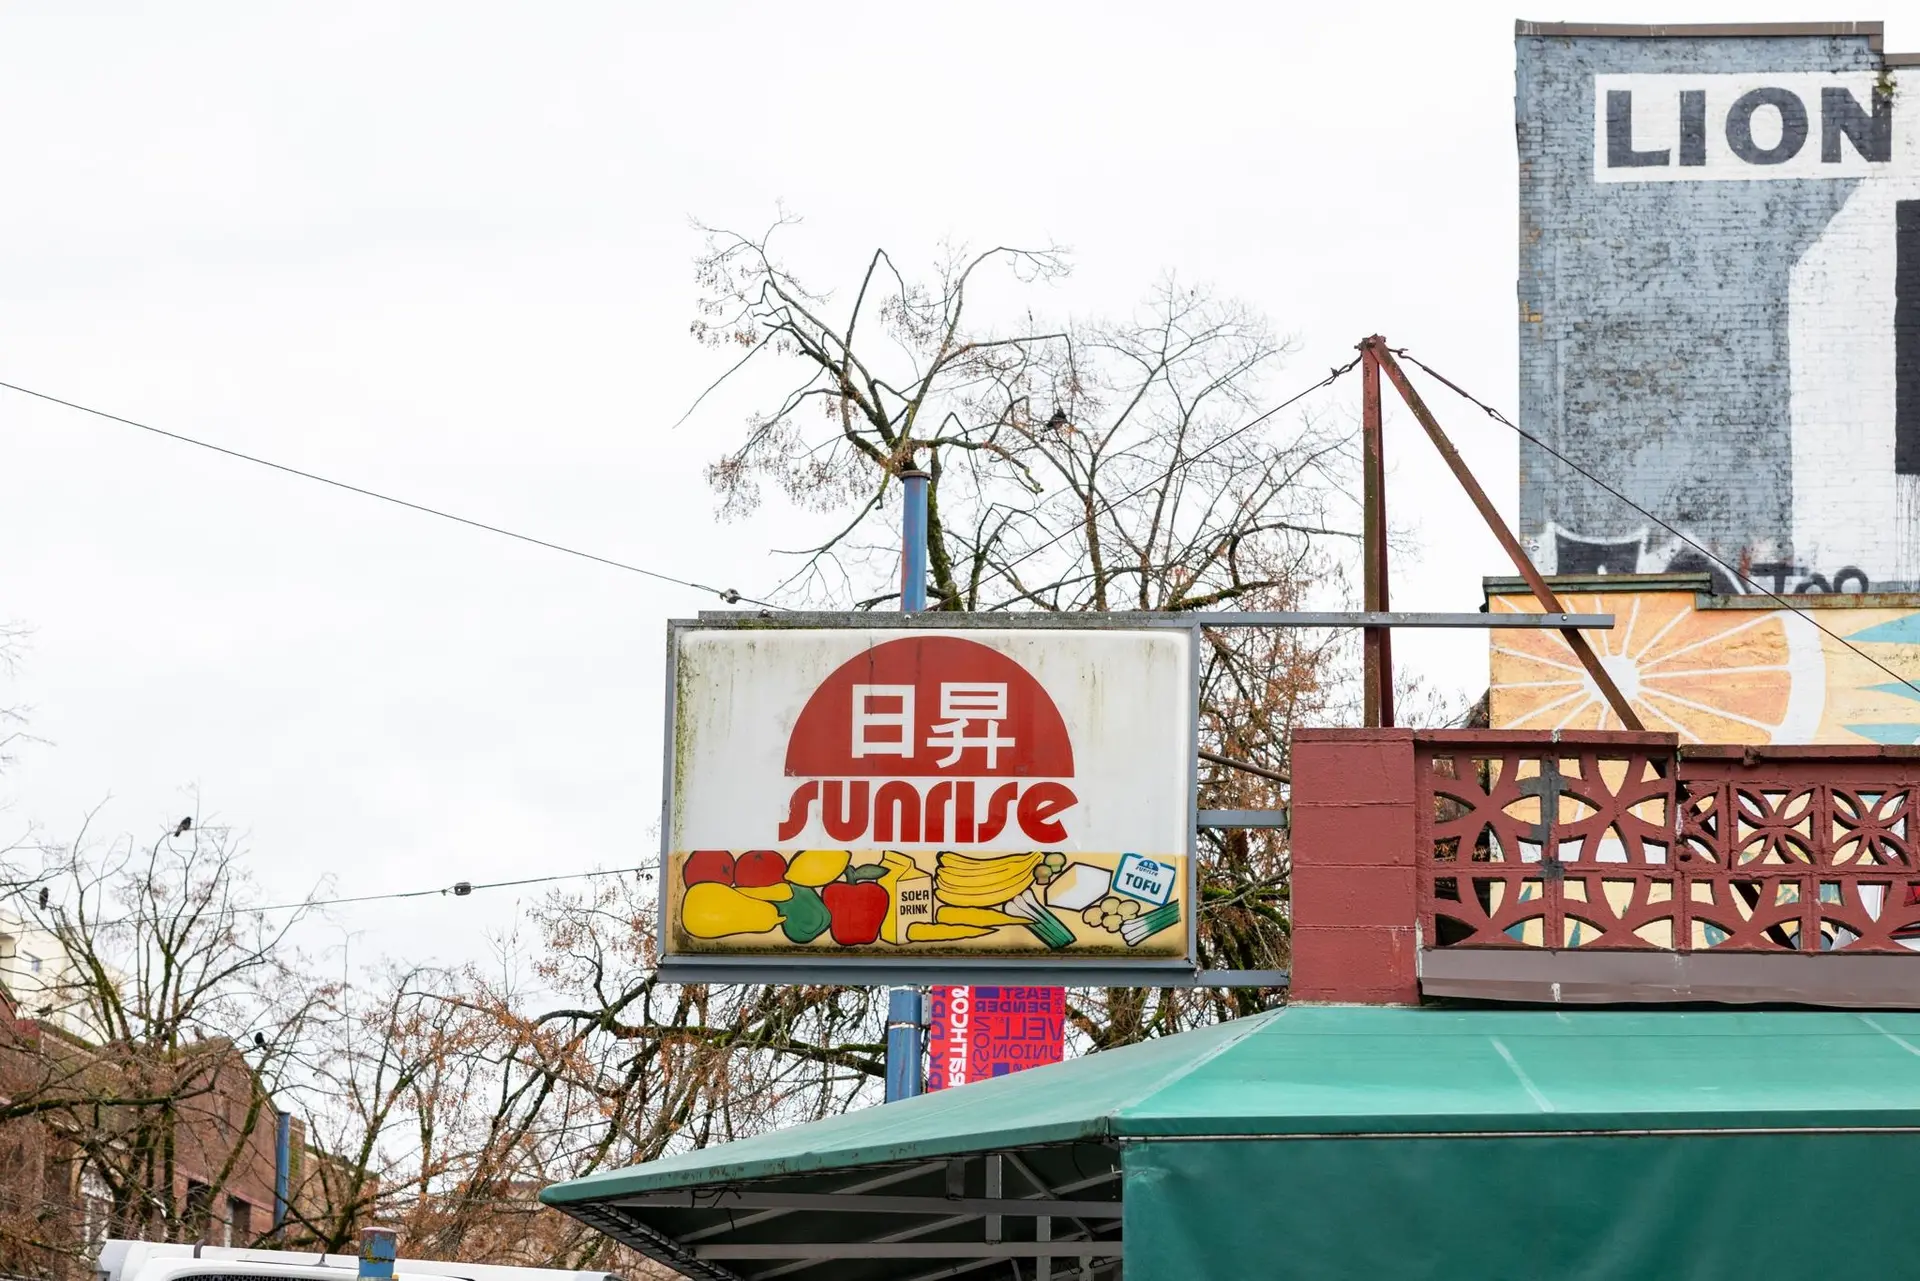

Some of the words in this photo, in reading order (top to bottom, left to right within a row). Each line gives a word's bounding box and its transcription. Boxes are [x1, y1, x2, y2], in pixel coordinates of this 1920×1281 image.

[1606, 86, 1892, 168] LION
[852, 682, 1015, 769] 日昇
[900, 904, 928, 915] DRINK
[1126, 872, 1161, 895] TOFU
